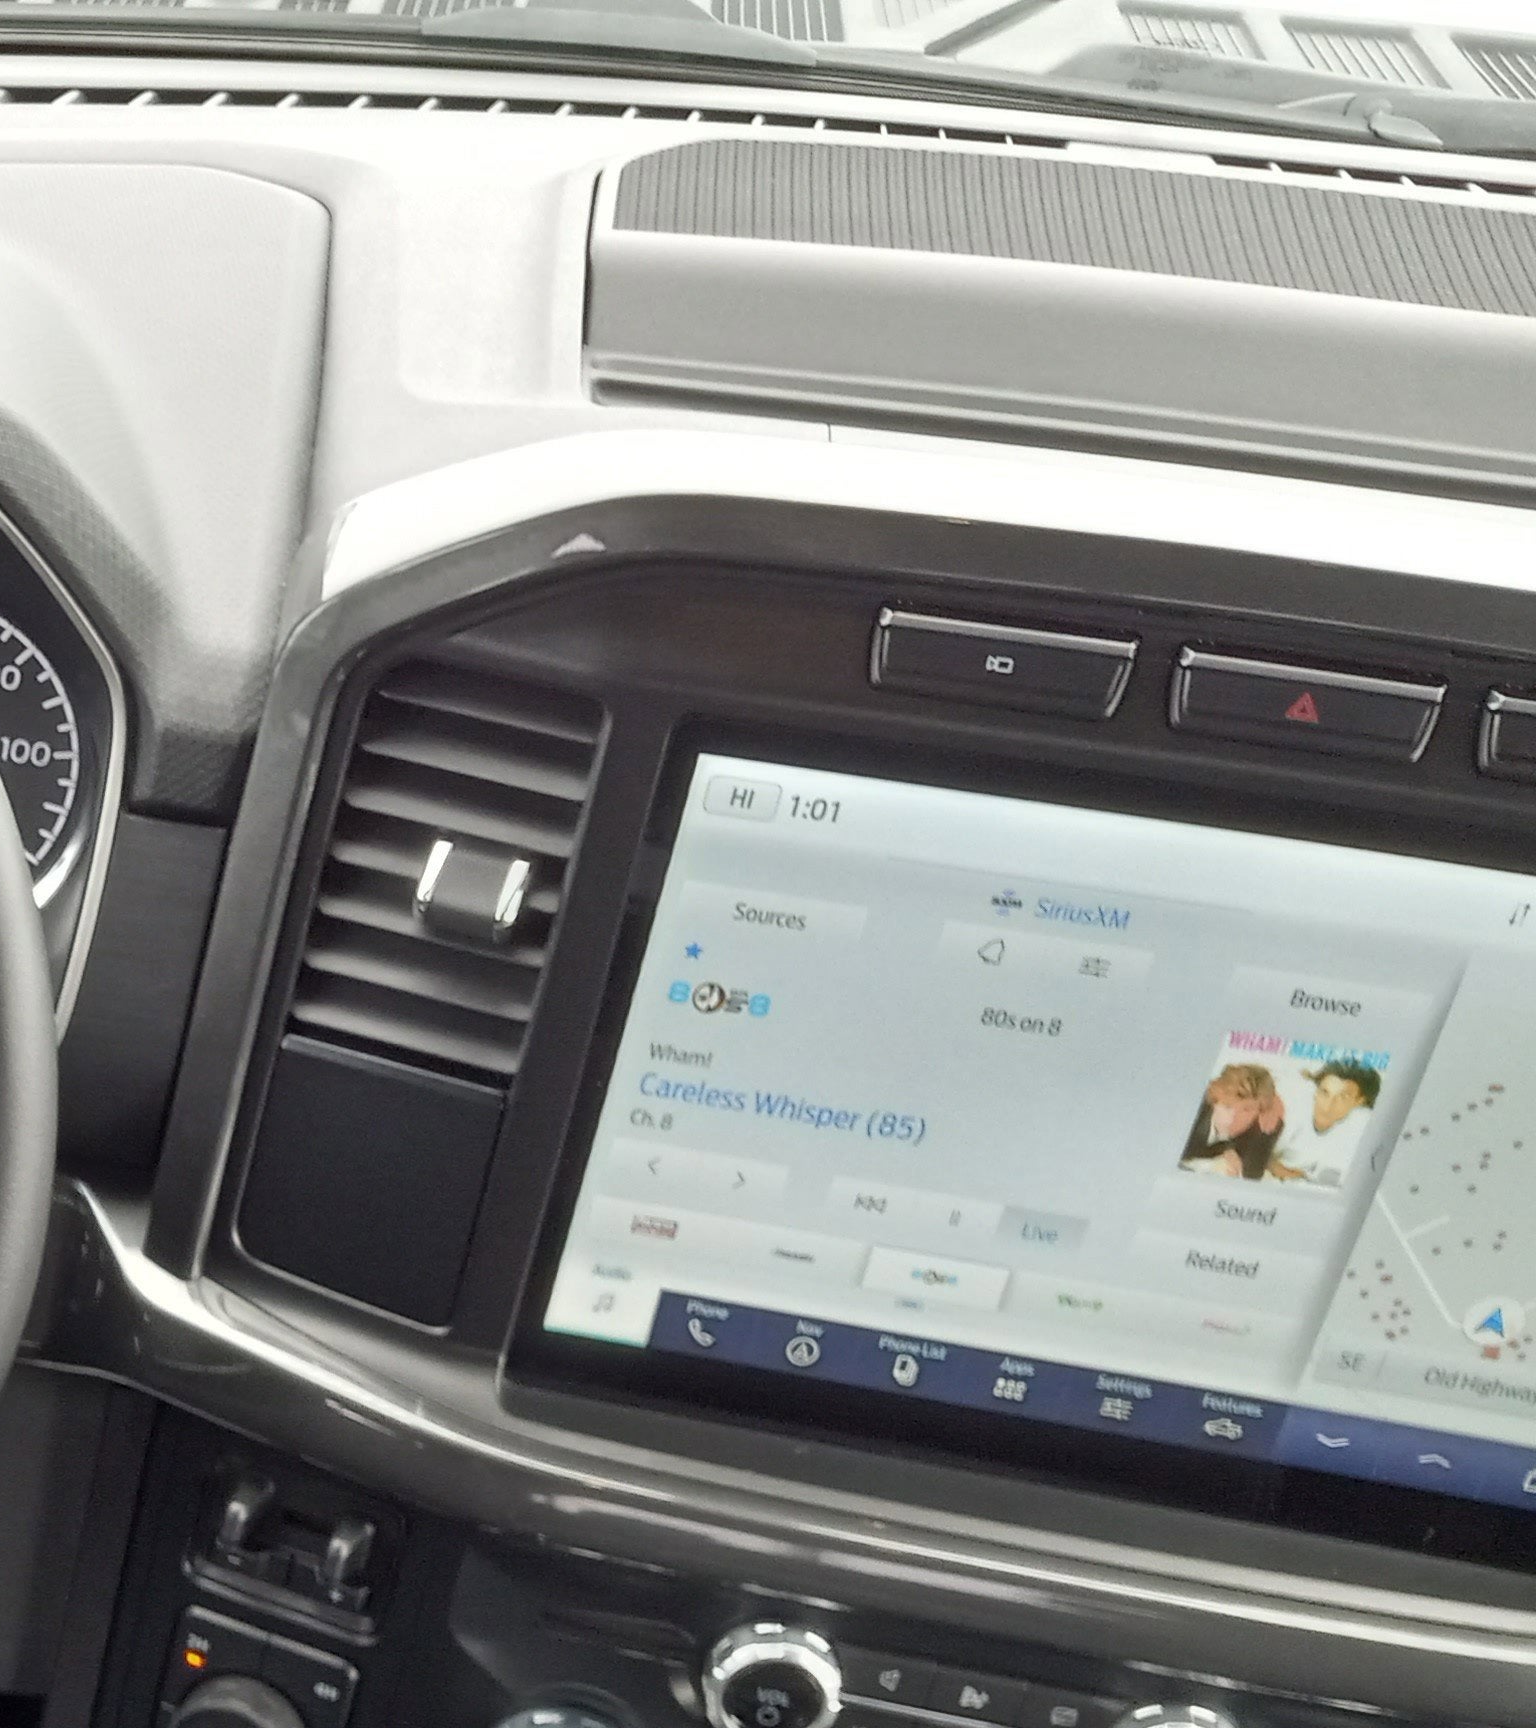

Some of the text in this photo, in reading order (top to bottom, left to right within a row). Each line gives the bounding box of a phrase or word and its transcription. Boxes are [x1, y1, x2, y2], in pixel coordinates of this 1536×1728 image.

[0, 736, 51, 766] 100
[730, 788, 755, 807] HI
[790, 797, 841, 823] 1:01
[734, 903, 807, 930] Sources
[1034, 897, 1130, 930] SiriusXM
[1290, 989, 1361, 1017] Browse
[981, 1007, 1063, 1036] 80s on 8
[650, 1043, 712, 1067] Wham!
[640, 1072, 926, 1145] Careless Whisper (85)
[1216, 1199, 1277, 1225] Sound
[1186, 1250, 1258, 1277] Related
[686, 1300, 729, 1321] Phone
[878, 1335, 920, 1356] Phone
